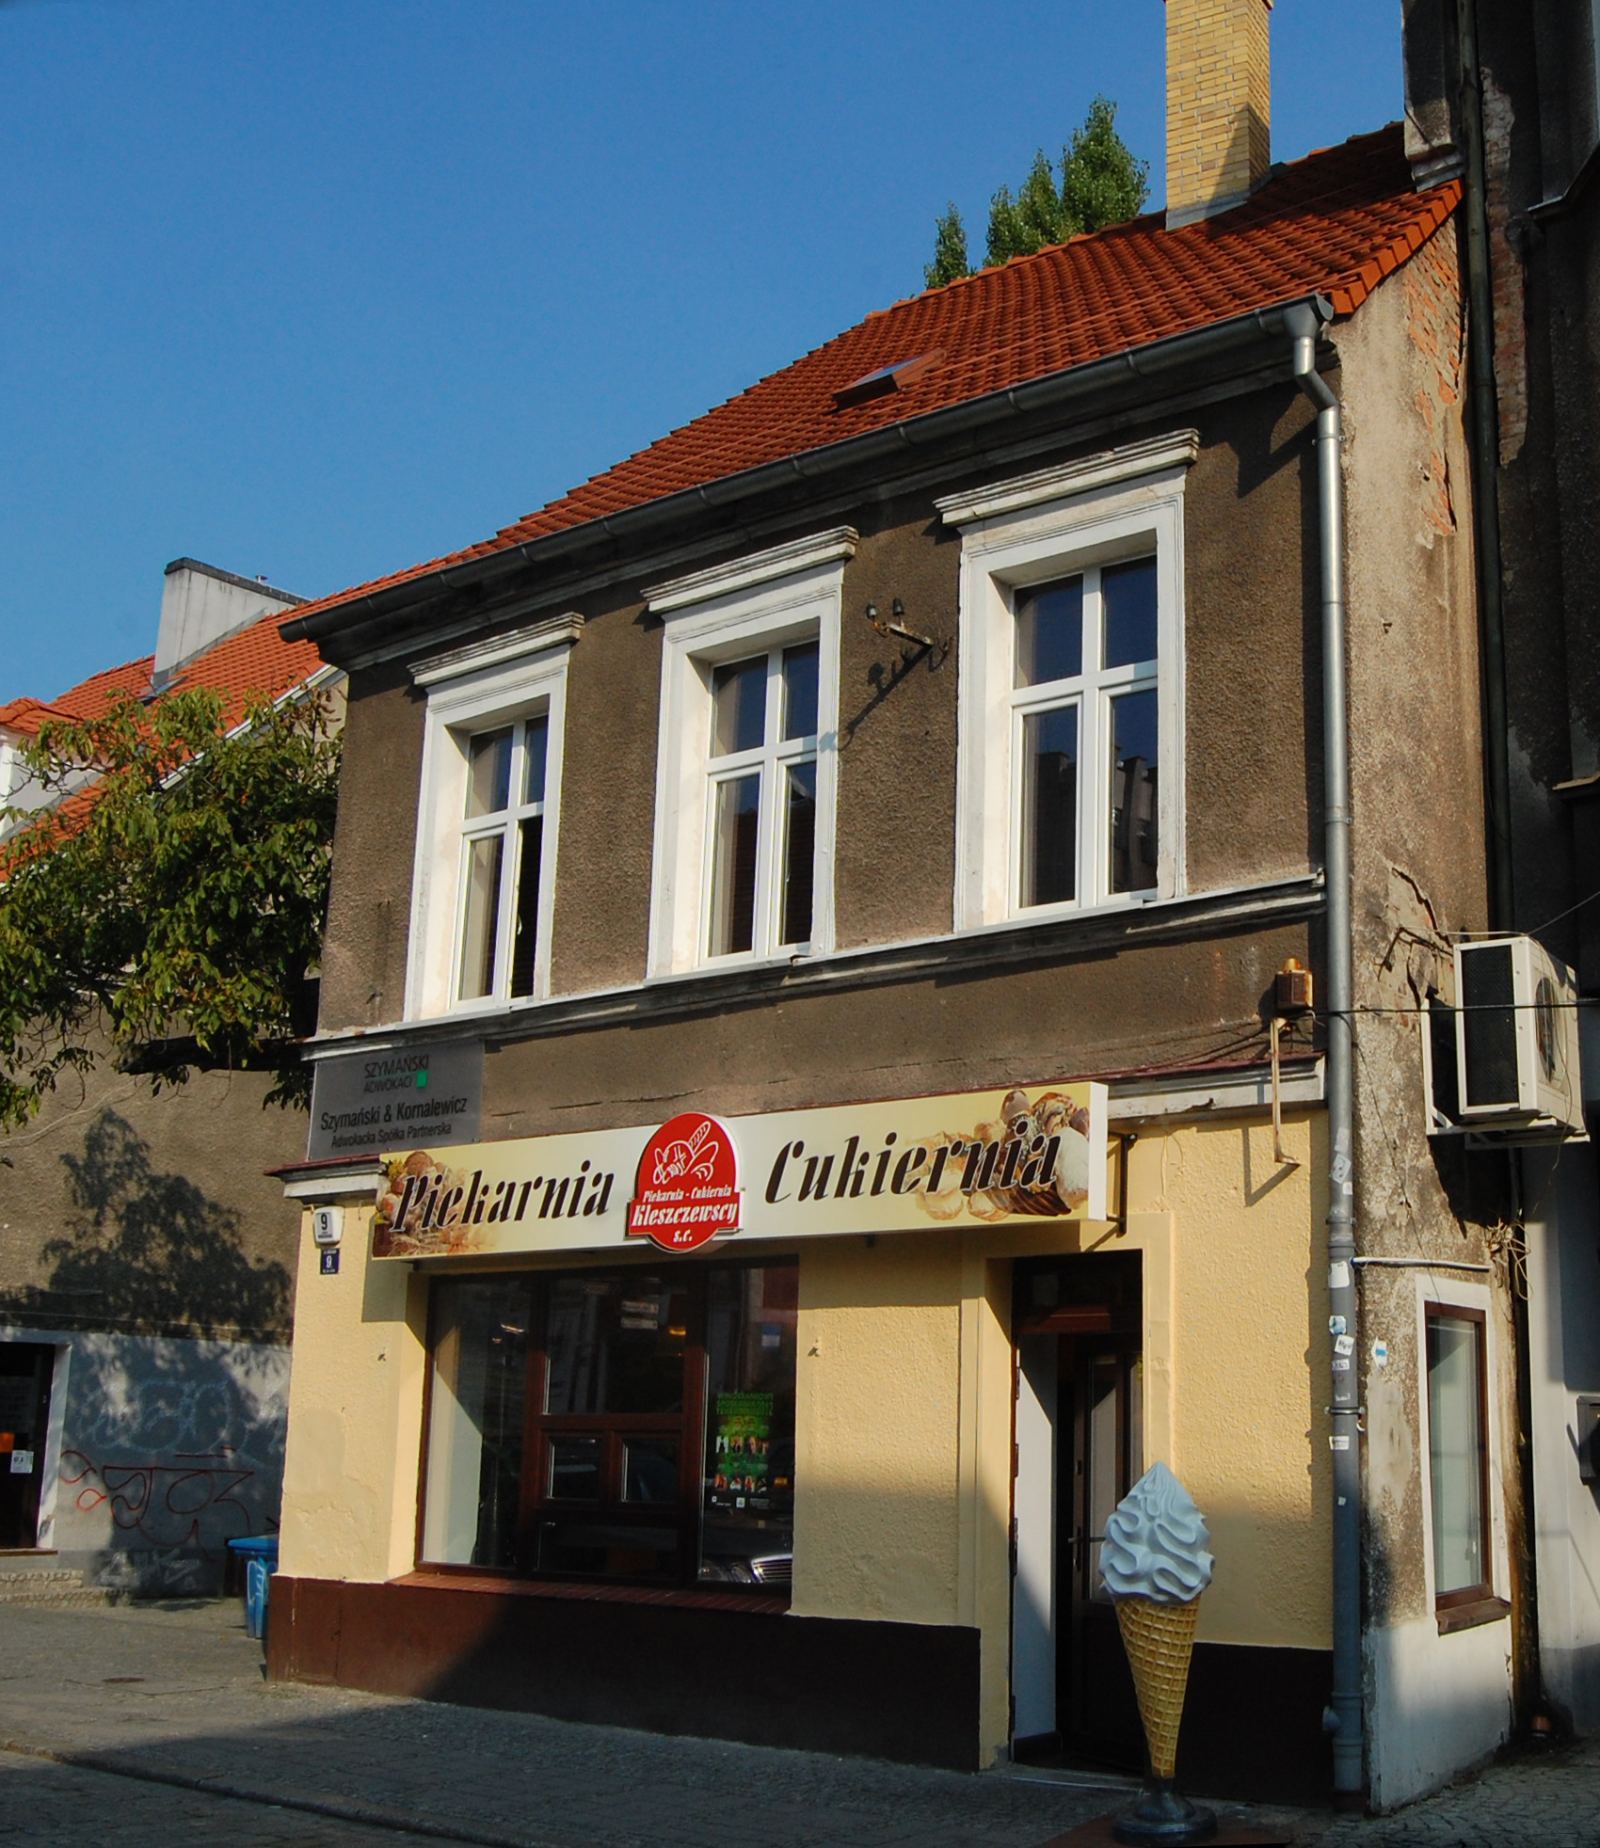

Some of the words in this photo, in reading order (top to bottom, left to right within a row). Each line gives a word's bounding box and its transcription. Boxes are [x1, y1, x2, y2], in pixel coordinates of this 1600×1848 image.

[364, 1054, 430, 1078] SZYMAŃSKI
[321, 1106, 382, 1133] Szymański
[384, 1105, 392, 1122] &
[397, 1097, 468, 1121] Kornalewicz
[407, 1122, 452, 1139] Partnerska
[765, 1119, 1061, 1204] Cukiernia
[389, 1159, 615, 1233] Piekarnia
[643, 1188, 684, 1203] Piekarnia
[691, 1184, 732, 1200] Cukiernia
[320, 1212, 329, 1231] 9
[632, 1202, 738, 1227] Kleszczewscy
[326, 1255, 333, 1269] 9
